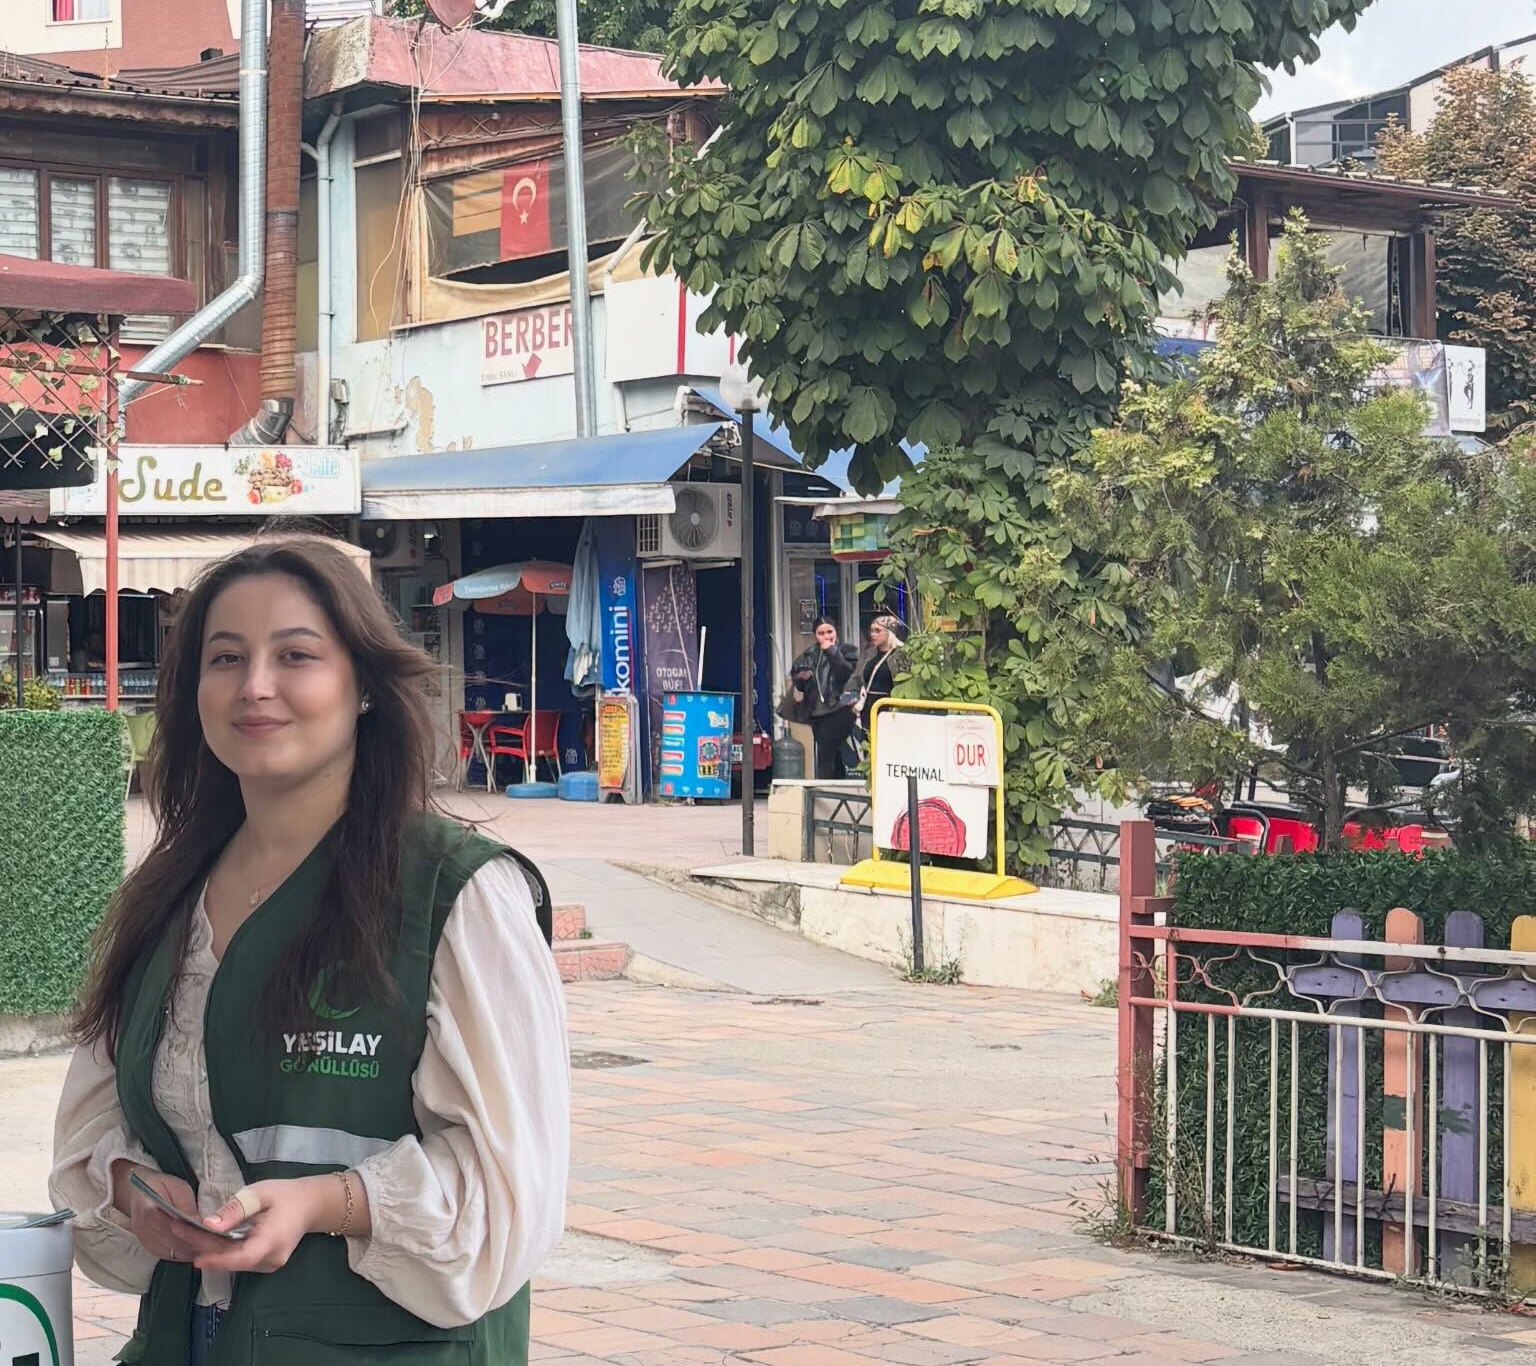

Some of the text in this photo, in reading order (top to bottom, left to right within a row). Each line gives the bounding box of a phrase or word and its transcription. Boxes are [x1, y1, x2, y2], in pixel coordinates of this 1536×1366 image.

[117, 455, 227, 503] Sude
[957, 743, 986, 767] DUR
[886, 763, 945, 782] TERMINAL
[283, 1031, 382, 1056] YEŞİLAY
